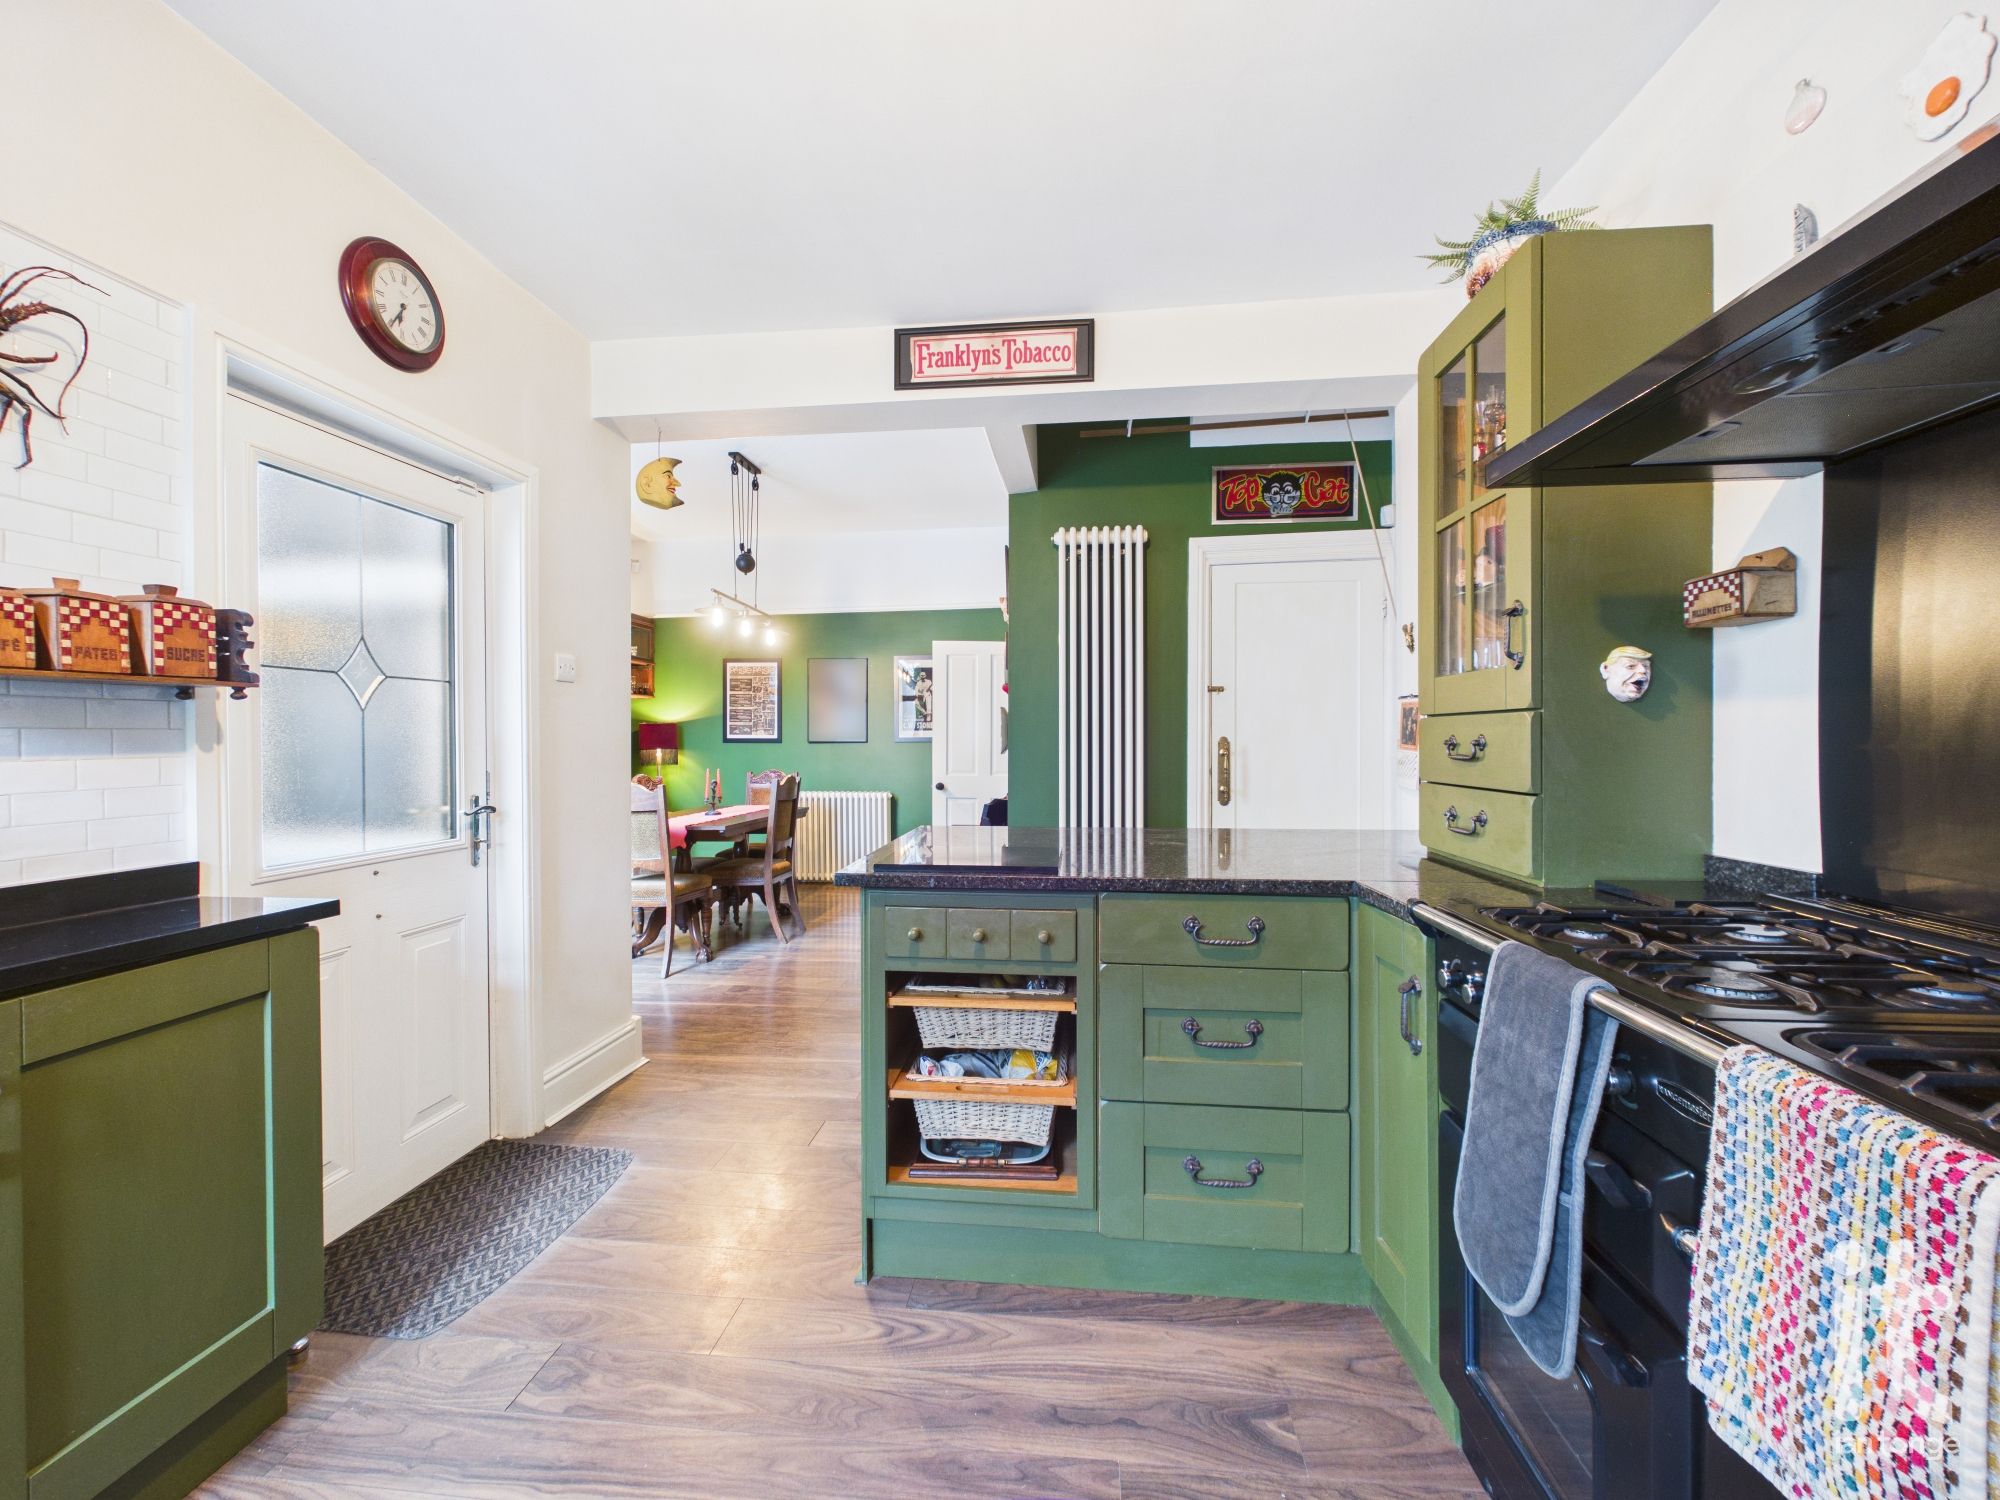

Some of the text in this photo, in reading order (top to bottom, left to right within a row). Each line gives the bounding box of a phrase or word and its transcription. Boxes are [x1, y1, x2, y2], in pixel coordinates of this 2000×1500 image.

[916, 338, 1072, 375] Franklyn's Tobacco
[1218, 470, 1350, 512] Top Cat
[166, 646, 206, 663] SUCRE
